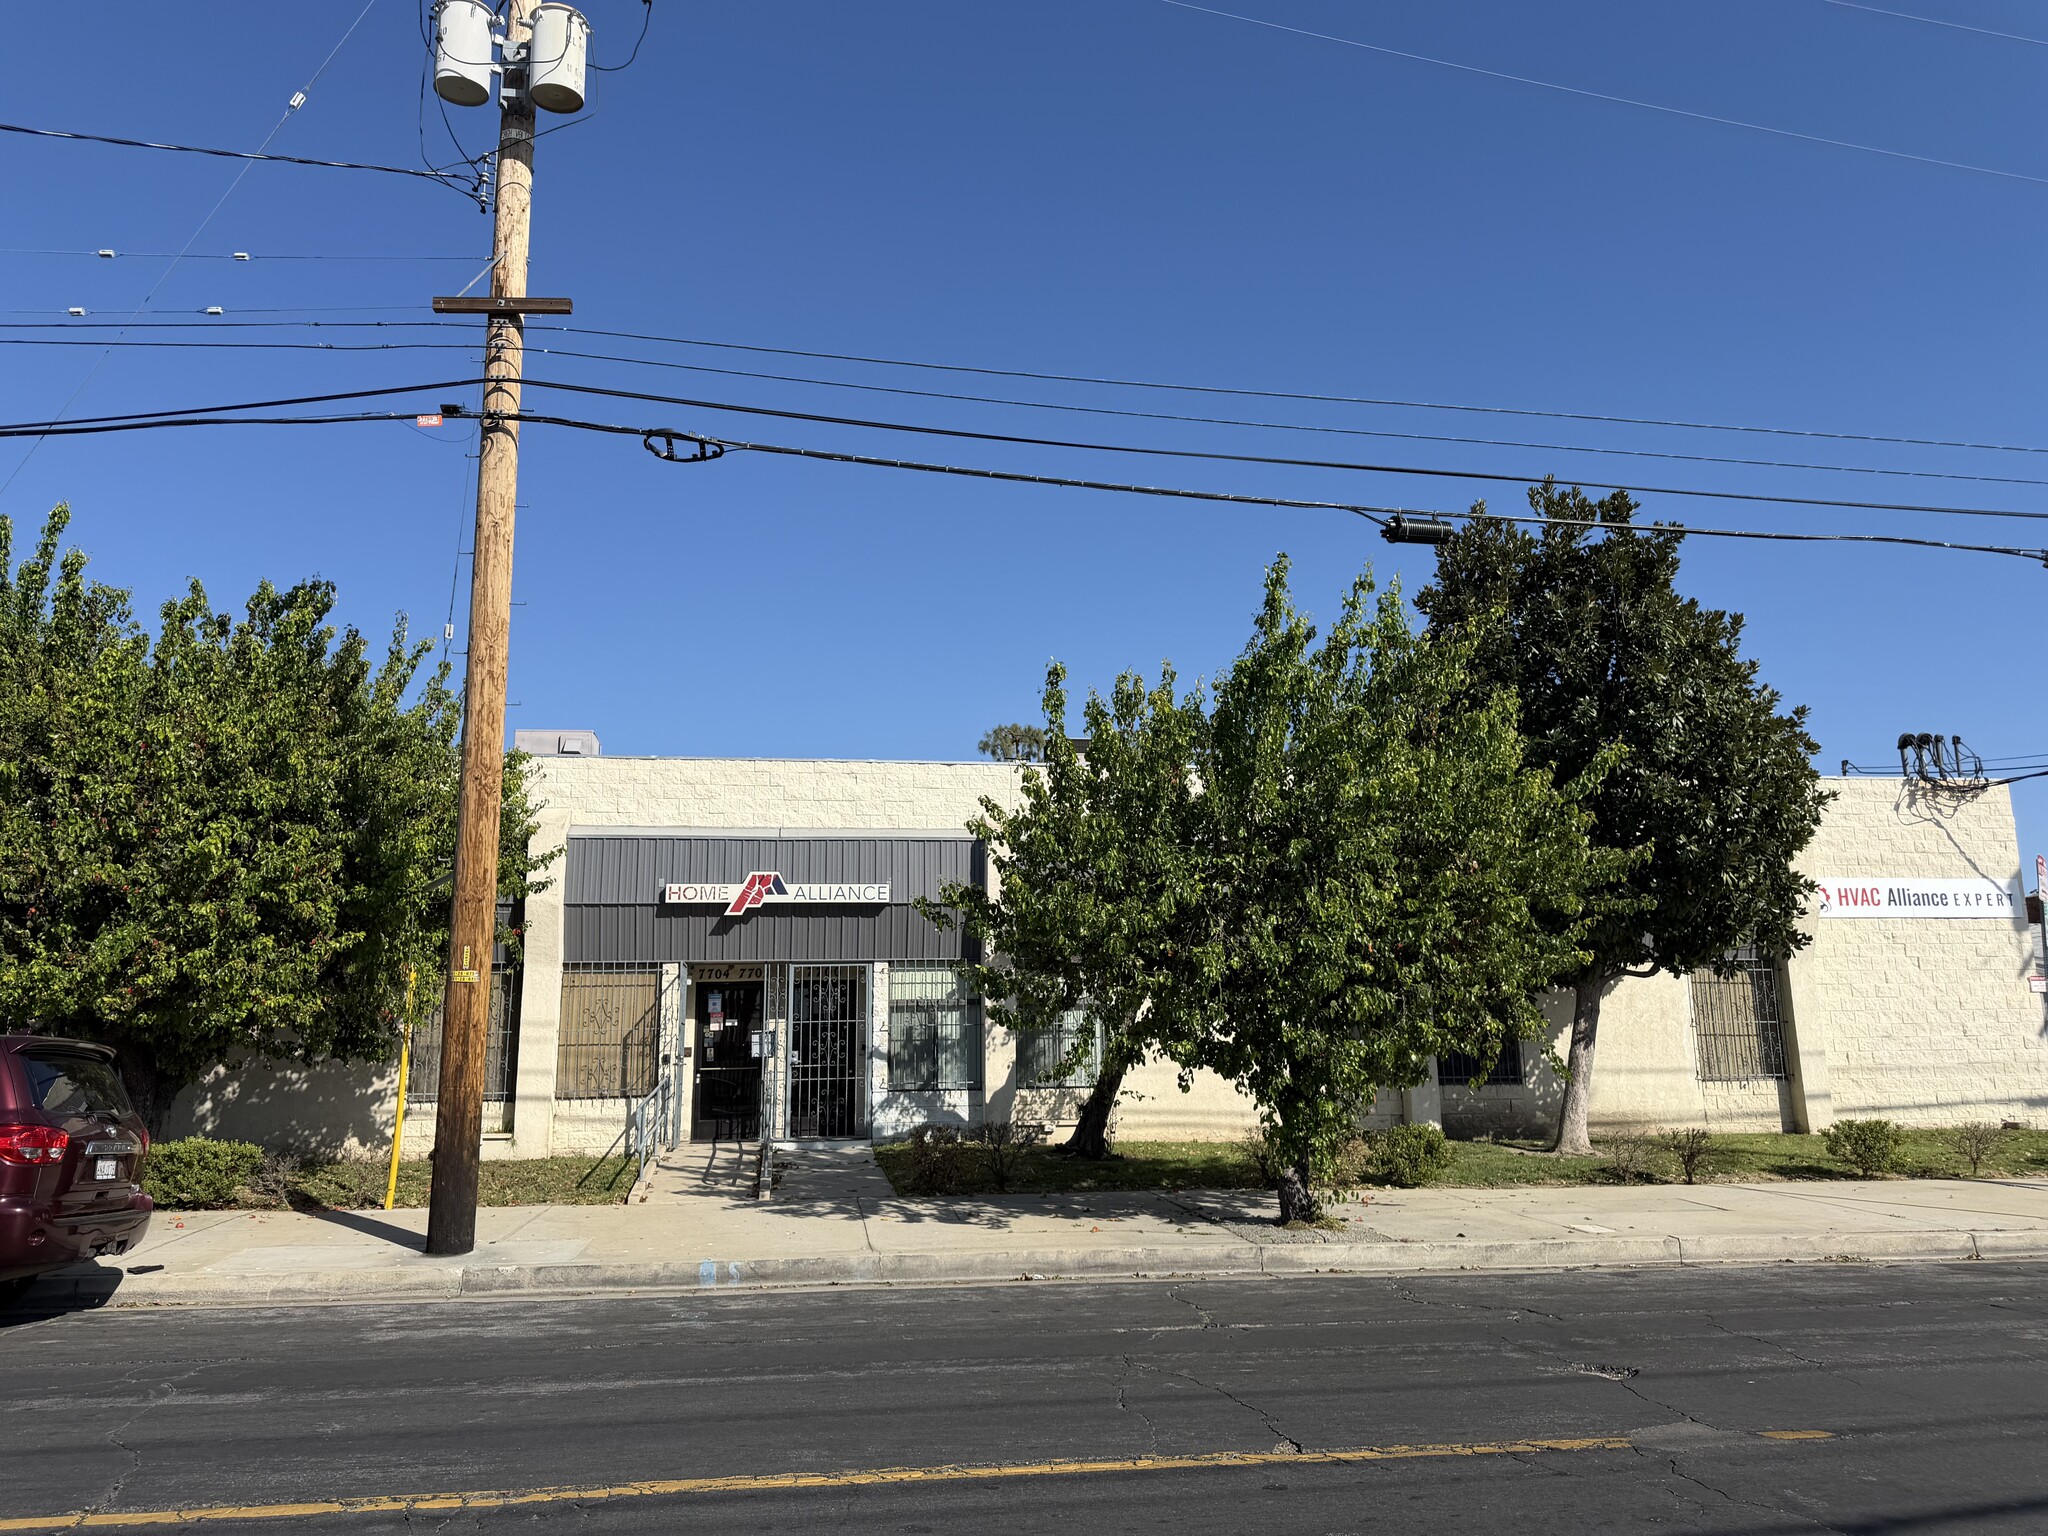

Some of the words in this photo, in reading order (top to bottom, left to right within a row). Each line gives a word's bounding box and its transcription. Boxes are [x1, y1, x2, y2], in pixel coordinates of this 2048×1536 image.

[668, 886, 729, 901] HOME
[793, 886, 888, 901] ALLIANCE
[1837, 887, 1881, 907] HVAC
[1887, 887, 1949, 907] Alliance
[1953, 893, 2014, 907] EXPERT
[698, 968, 730, 980] 7704
[739, 968, 765, 980] 770
